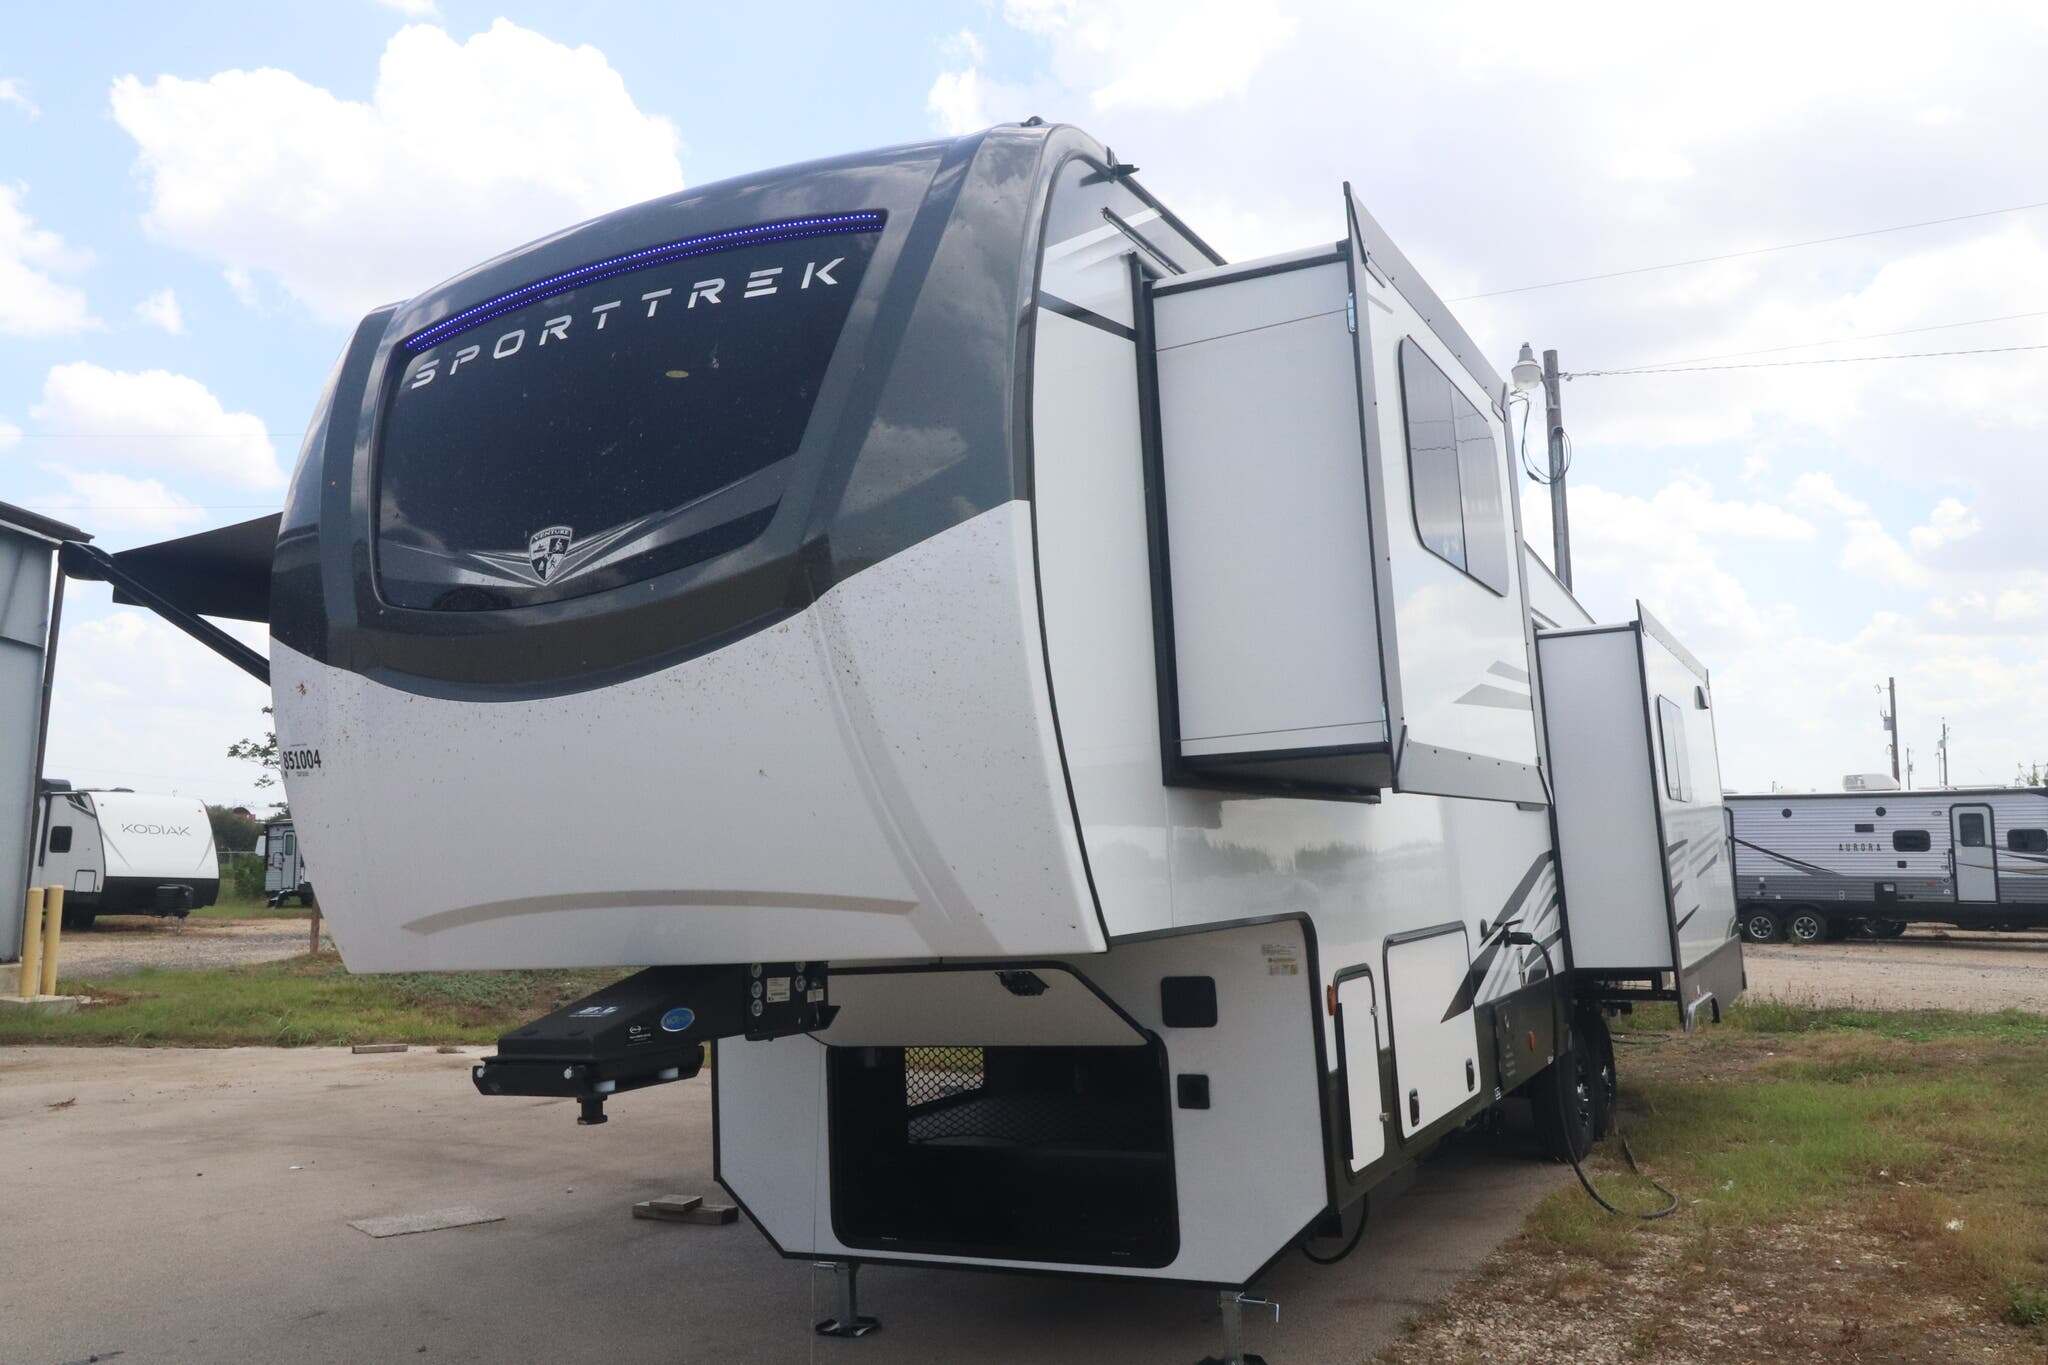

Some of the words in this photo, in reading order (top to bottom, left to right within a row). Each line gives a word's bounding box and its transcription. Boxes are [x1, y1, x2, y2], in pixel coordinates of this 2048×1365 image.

[411, 257, 844, 389] SPORTTREK
[282, 749, 321, 770] 851004
[121, 823, 192, 836] KODIAK
[1839, 842, 1881, 852] AURORA
